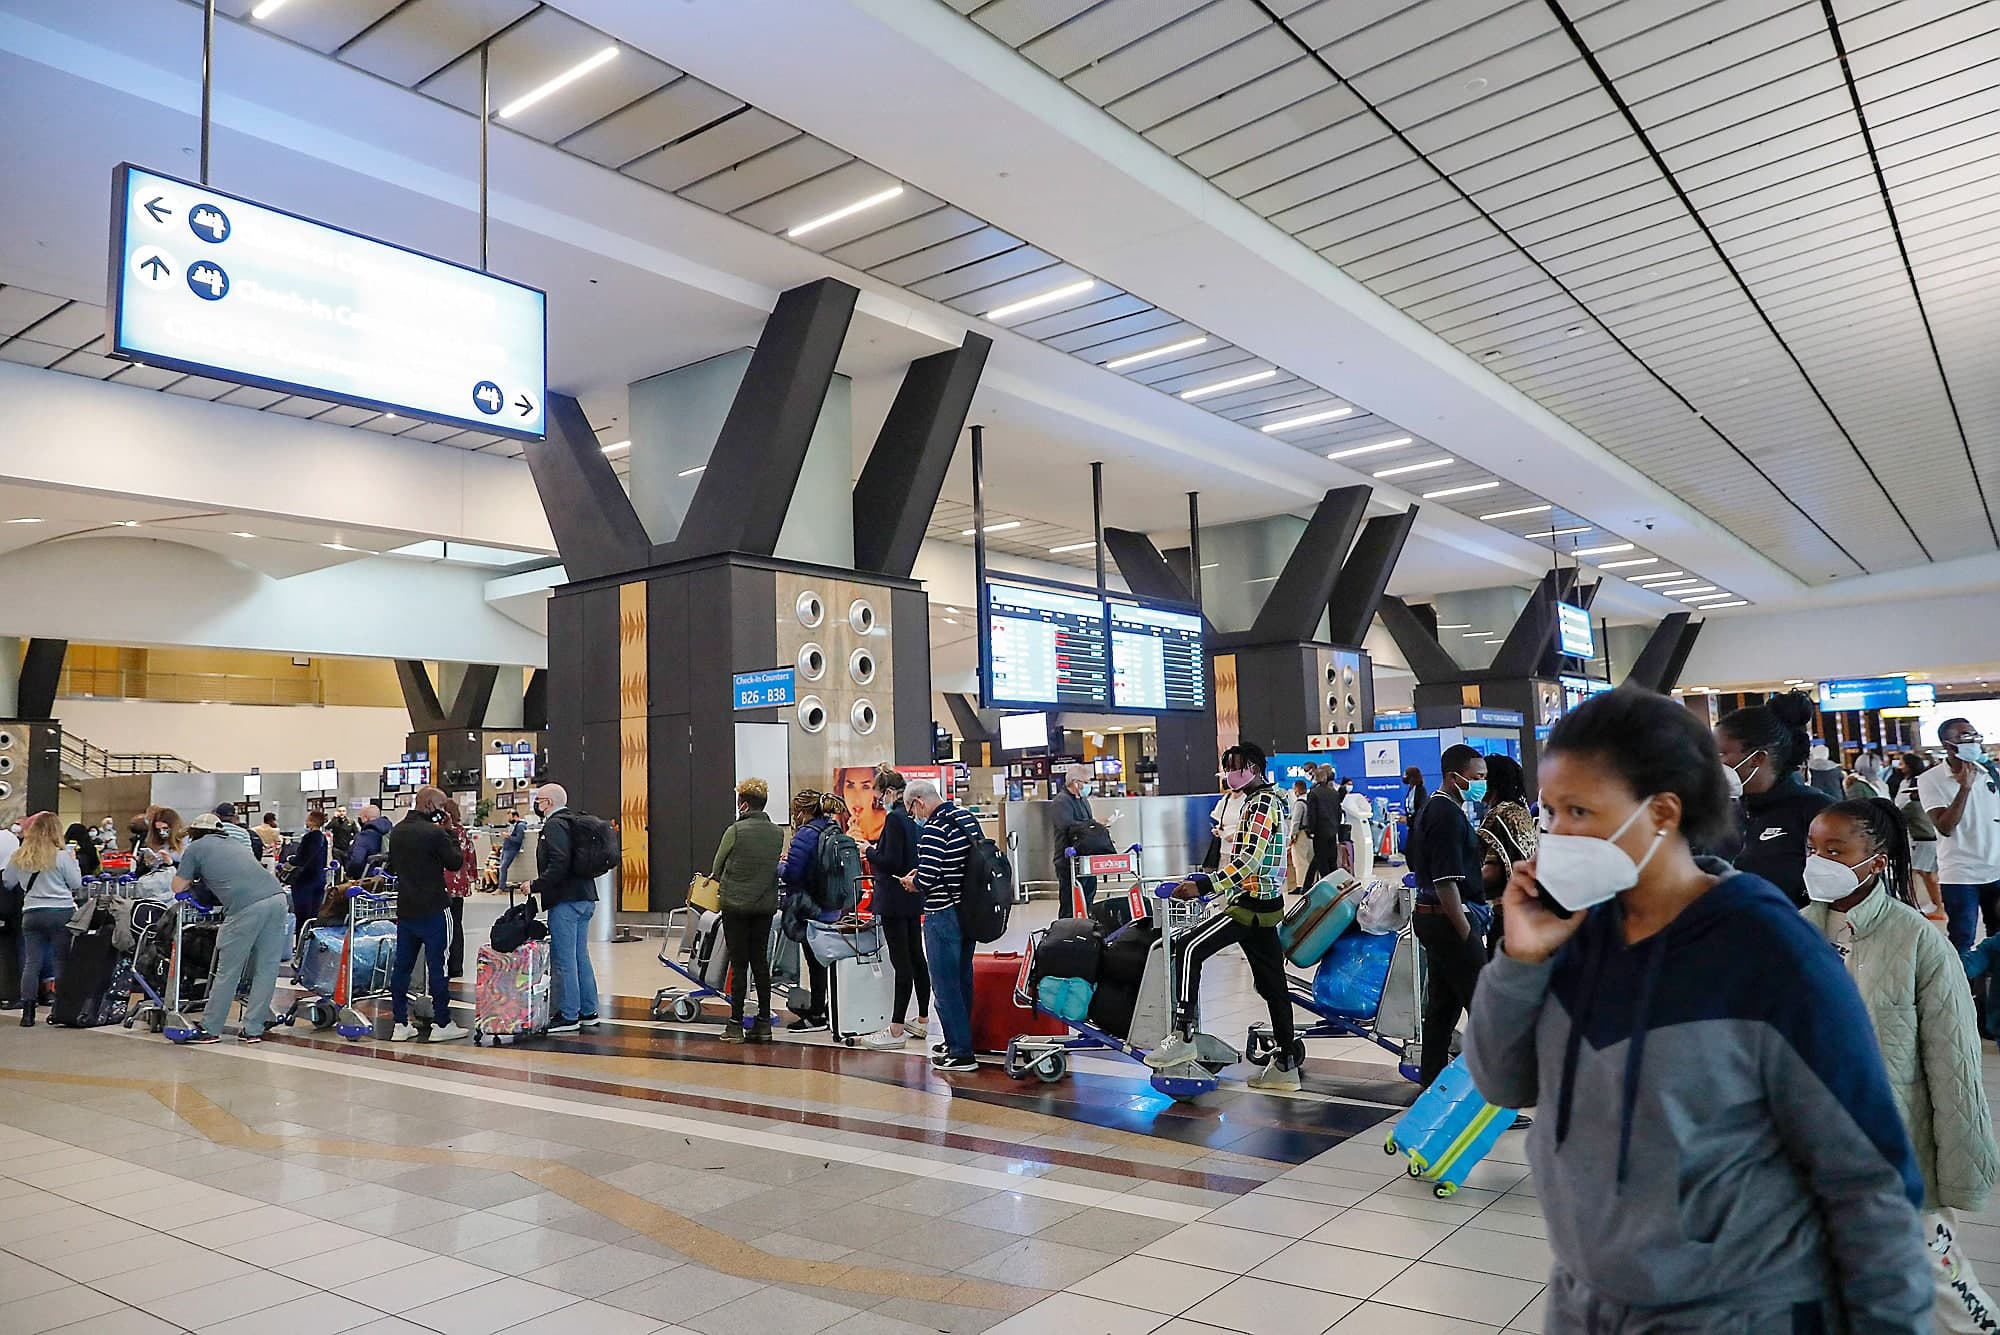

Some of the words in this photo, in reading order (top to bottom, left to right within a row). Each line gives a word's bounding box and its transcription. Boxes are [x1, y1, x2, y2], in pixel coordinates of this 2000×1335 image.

[762, 673, 789, 682] Counters
[741, 690, 759, 705] B26
[767, 687, 786, 702] B38
